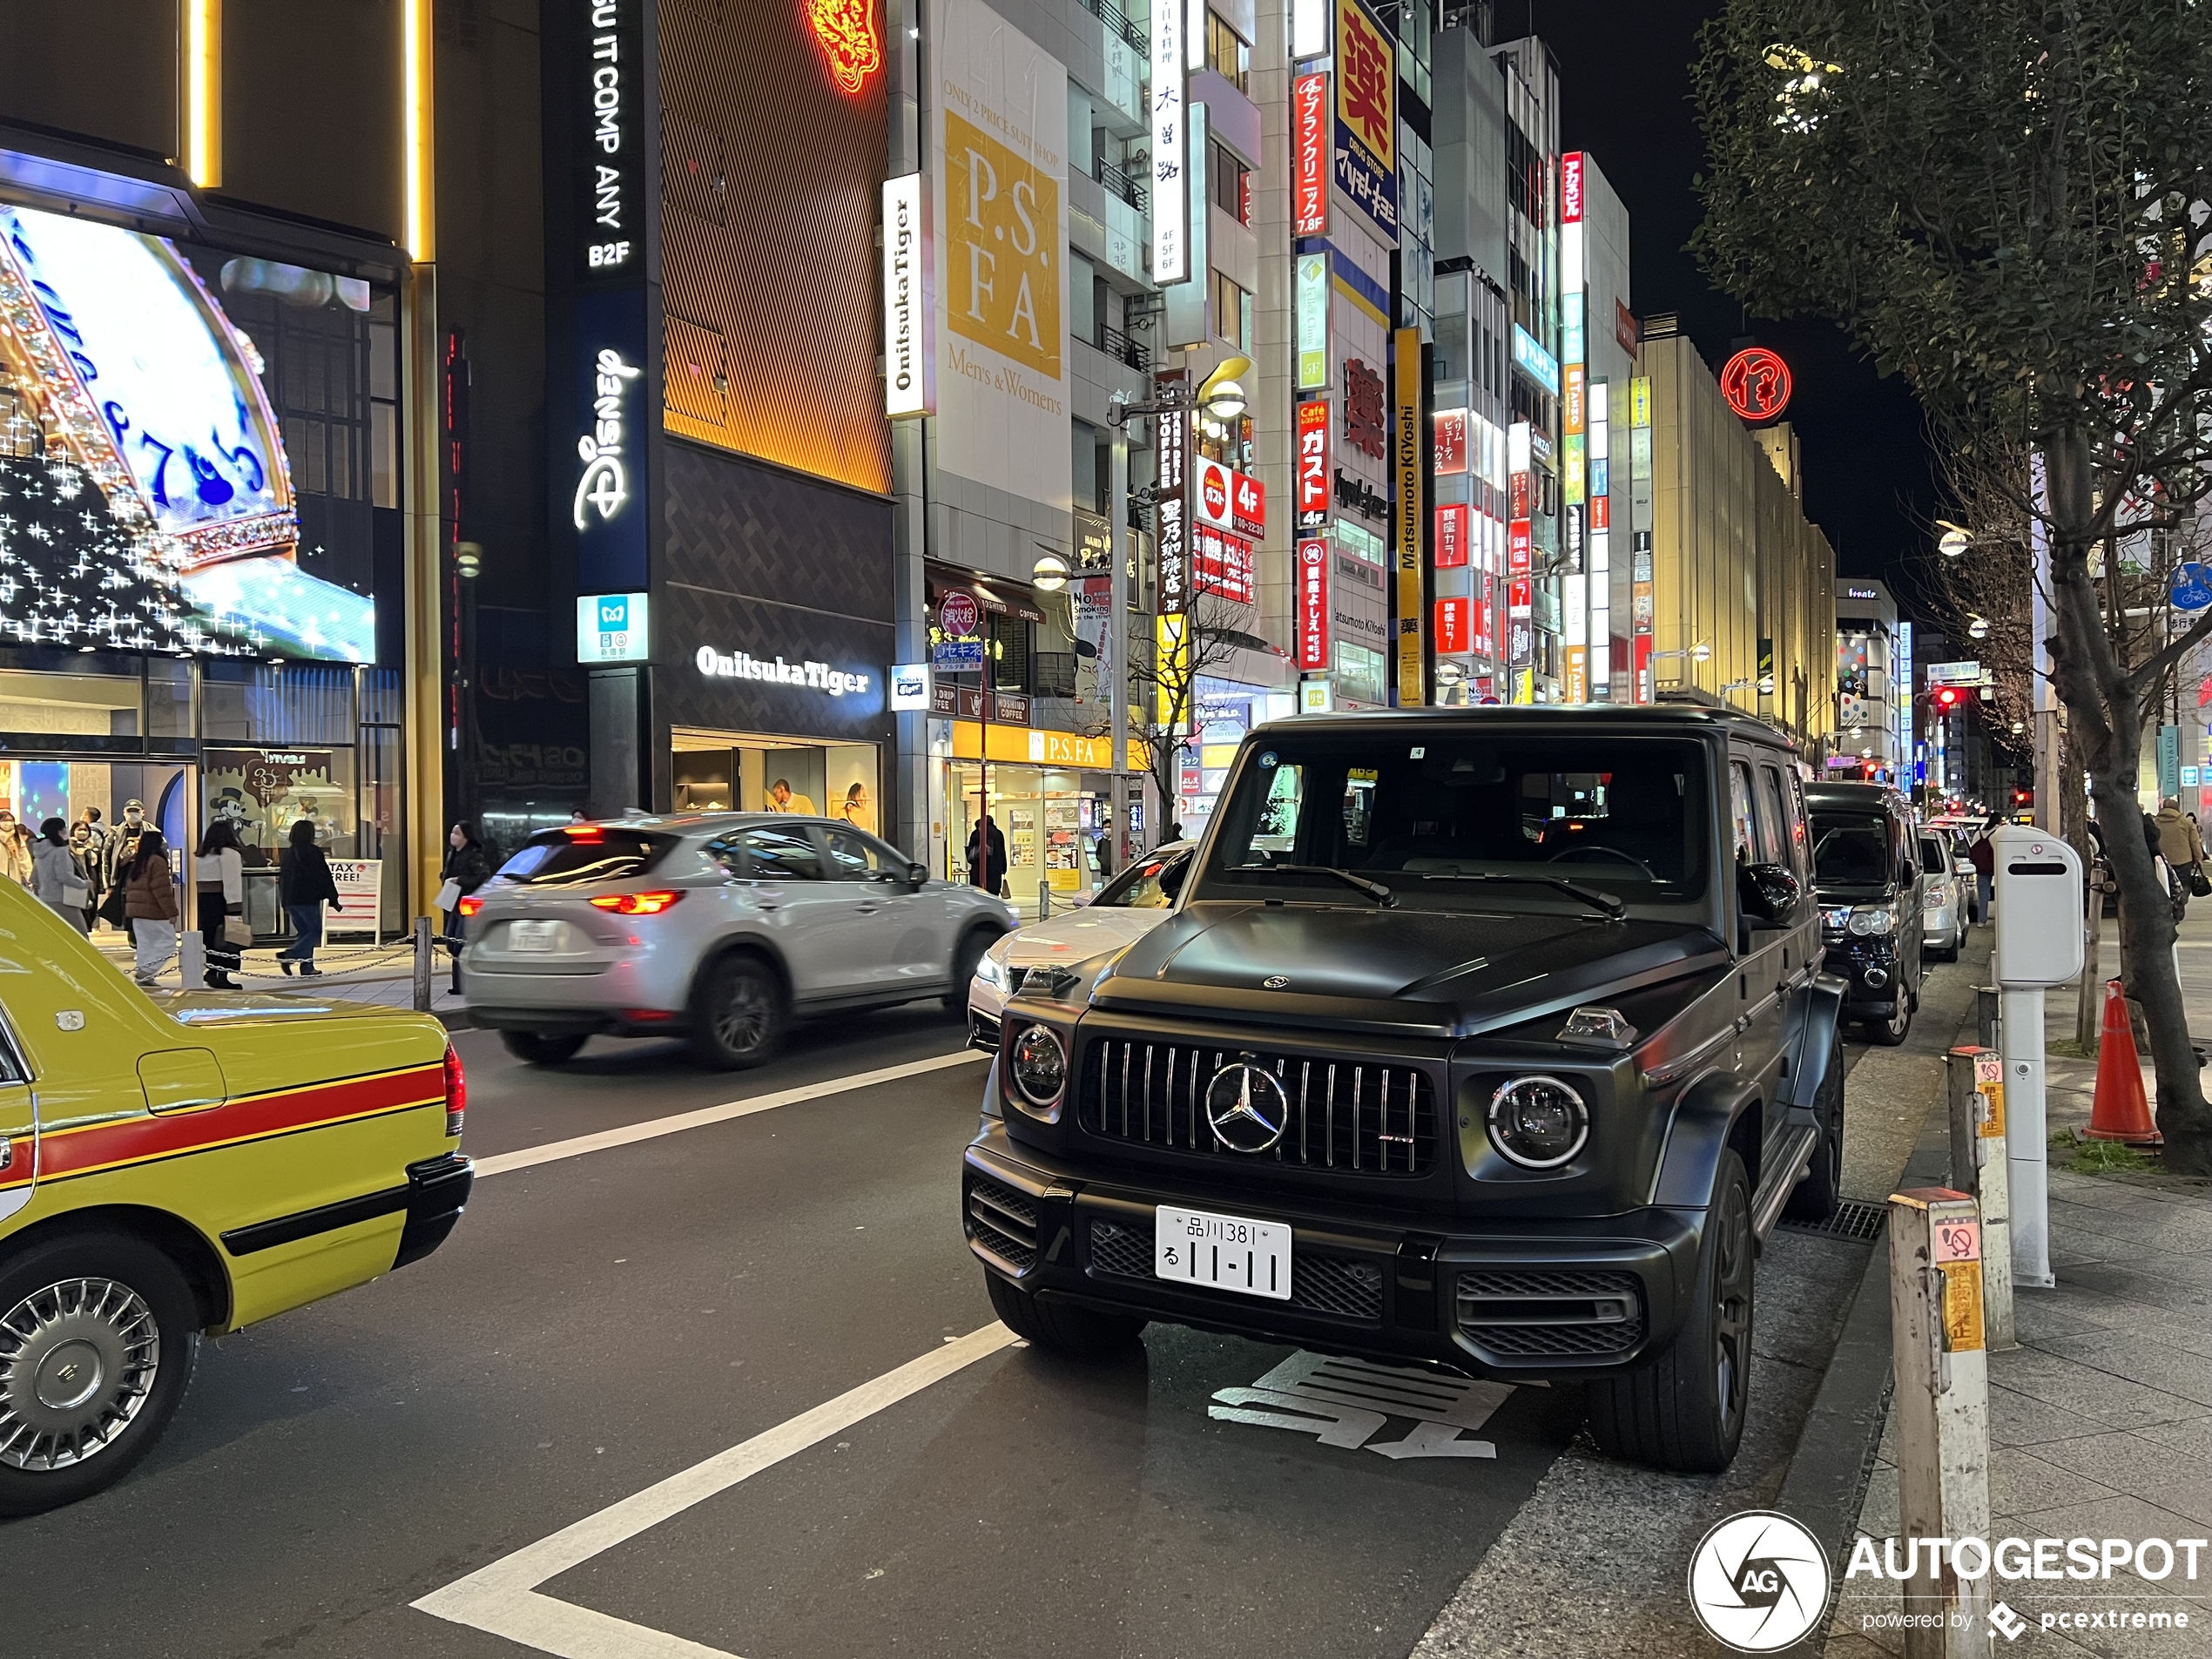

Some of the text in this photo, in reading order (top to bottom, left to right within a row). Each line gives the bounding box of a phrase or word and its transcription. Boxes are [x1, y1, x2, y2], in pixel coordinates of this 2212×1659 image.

[1162, 9, 1173, 64] 日本料理
[1344, 11, 1388, 156] 薬
[943, 79, 1060, 167] ONLY 2 PRICE SUIT SHOP
[1302, 98, 1318, 218] ブランクリニック
[1349, 136, 1385, 181] DRUG STORE
[1565, 160, 1579, 216] アカネビル
[1163, 231, 1174, 240] 4F
[589, 241, 630, 267] B2F
[1163, 245, 1175, 255] 5F
[1163, 259, 1175, 269] 6F
[894, 199, 912, 391] OnitsukaTiger
[967, 239, 1044, 353] FA
[948, 342, 1062, 416] Men's & Women's
[1305, 362, 1320, 375] 5F
[1300, 406, 1325, 416] Café
[1300, 416, 1325, 425] レストラン
[1347, 358, 1385, 460] 薬
[574, 348, 641, 530] Disney
[1454, 414, 1463, 442] スリム
[1160, 413, 1171, 489] COFFEE
[1444, 421, 1453, 461] ビューティ
[1302, 428, 1324, 503] ガスト
[1434, 444, 1443, 470] ハウス
[1206, 487, 1225, 505] ガスト
[1238, 480, 1257, 512] 4F
[1400, 405, 1415, 570] Matsumoto KiYoshi
[1303, 510, 1324, 524] 4F
[1443, 509, 1455, 565] 銀座カラー
[1513, 536, 1527, 606] 銀座ラー
[1074, 592, 1092, 604] No
[1307, 567, 1320, 631] 銀座よしえ
[1849, 587, 1877, 598] frente
[945, 608, 974, 624] 消火栓
[1019, 609, 1039, 621] COFFEE
[1075, 605, 1109, 616] Smoking
[1365, 617, 1386, 637] KiYoshi
[1401, 617, 1418, 634] 薬
[1444, 603, 1455, 649] 銀座カラー
[1513, 625, 1521, 645] Free
[946, 644, 982, 658] セキネ
[1513, 644, 1521, 660] Tax
[696, 645, 868, 696] OnitsukaTiger
[940, 689, 954, 699] DRIP
[1309, 692, 1322, 704] リゼ
[1468, 686, 1481, 695] No
[934, 699, 949, 710] FFEE
[998, 698, 1026, 711] HOSHINO
[1001, 710, 1023, 720] COFFEE
[330, 864, 354, 873] TAX
[331, 873, 360, 882] FREE!
[1187, 1217, 1256, 1245] 品川 381
[1163, 1241, 1278, 1291] る 11-11
